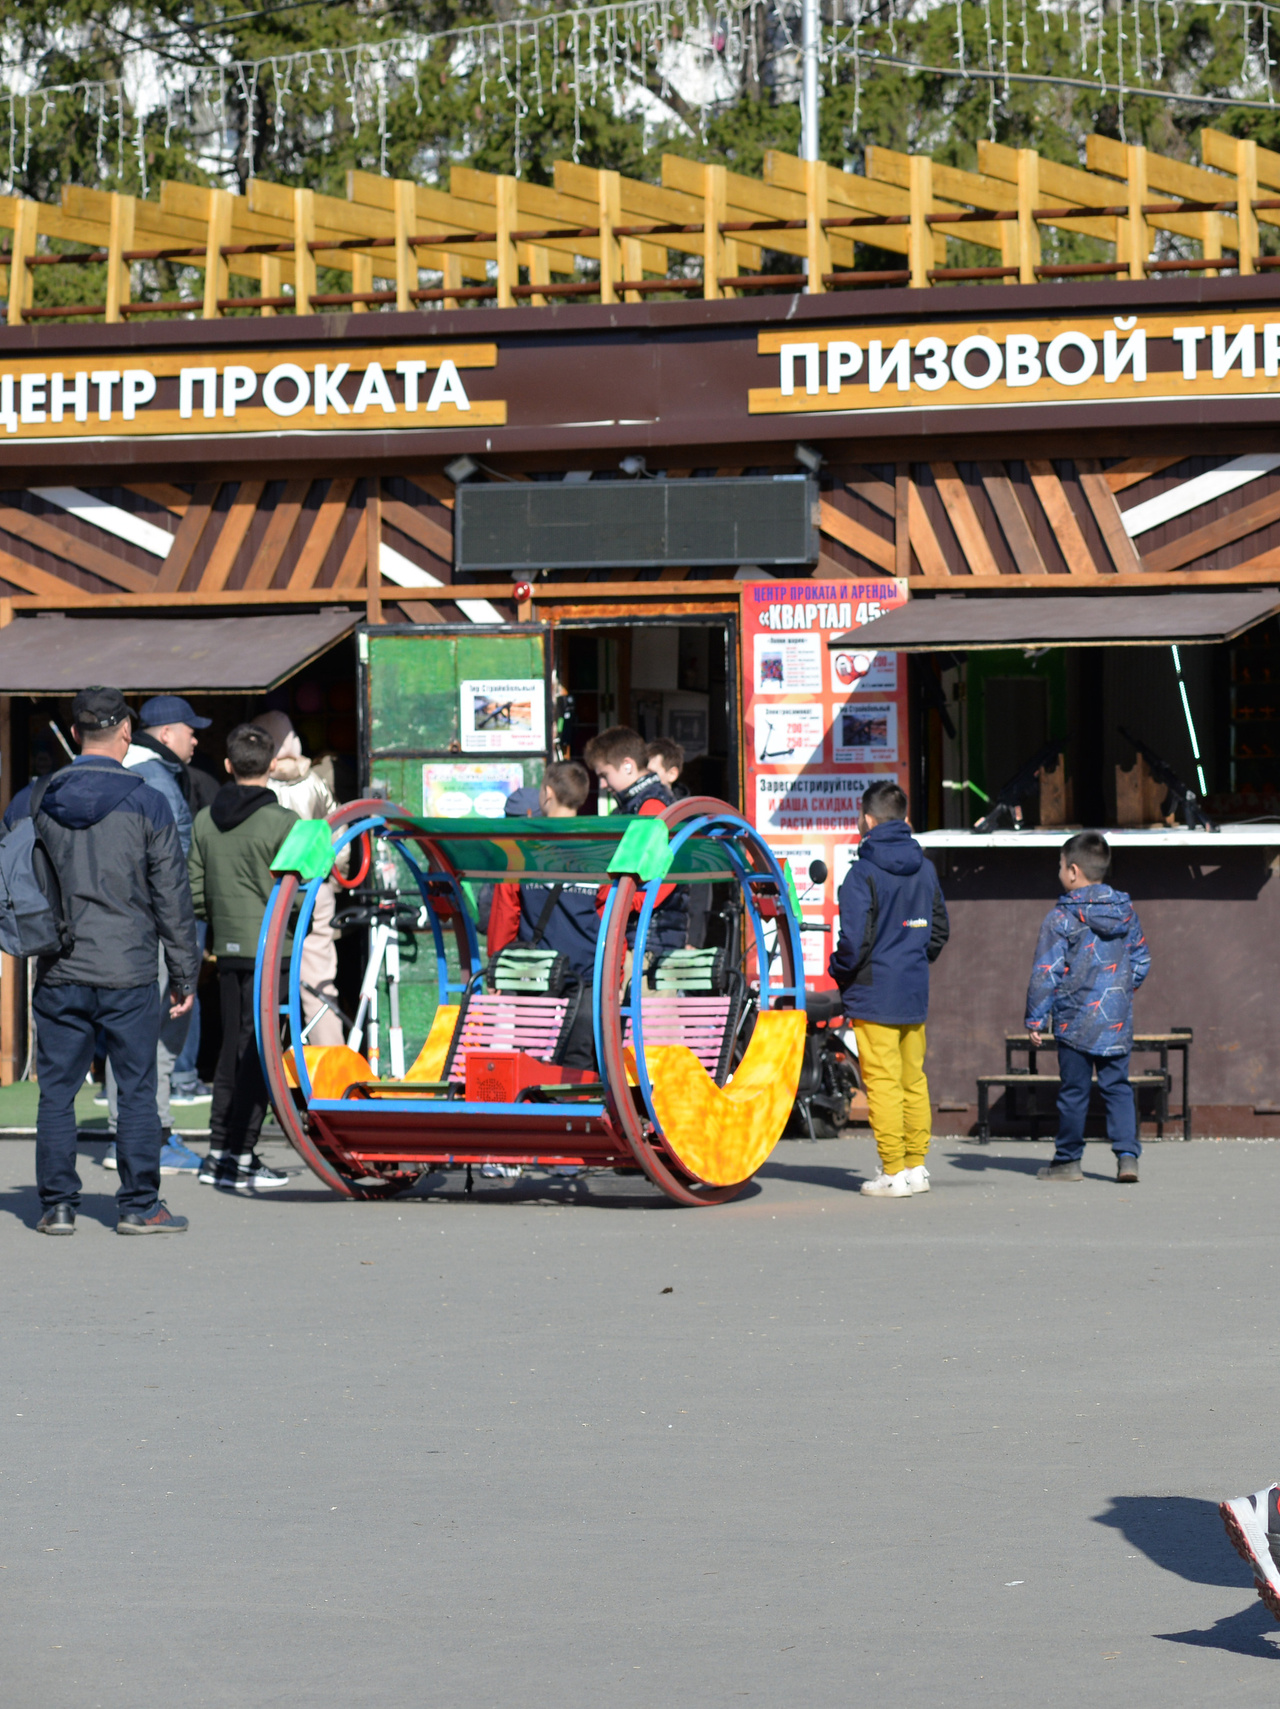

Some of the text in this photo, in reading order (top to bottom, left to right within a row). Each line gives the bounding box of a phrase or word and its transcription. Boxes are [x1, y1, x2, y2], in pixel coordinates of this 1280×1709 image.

[779, 315, 1148, 396] ПРИЗОВОЙ
[179, 359, 471, 419] ПРОКАТА
[754, 584, 897, 603] ЦЕНТР ПРОКАТА И АРЕНДЫ
[758, 602, 852, 630] «КВАРТАЛ
[760, 779, 865, 793] Зарегистрируйтесь
[780, 797, 808, 812] ВАША
[811, 796, 852, 813] СКИДКА
[780, 817, 813, 831] РАСТИ
